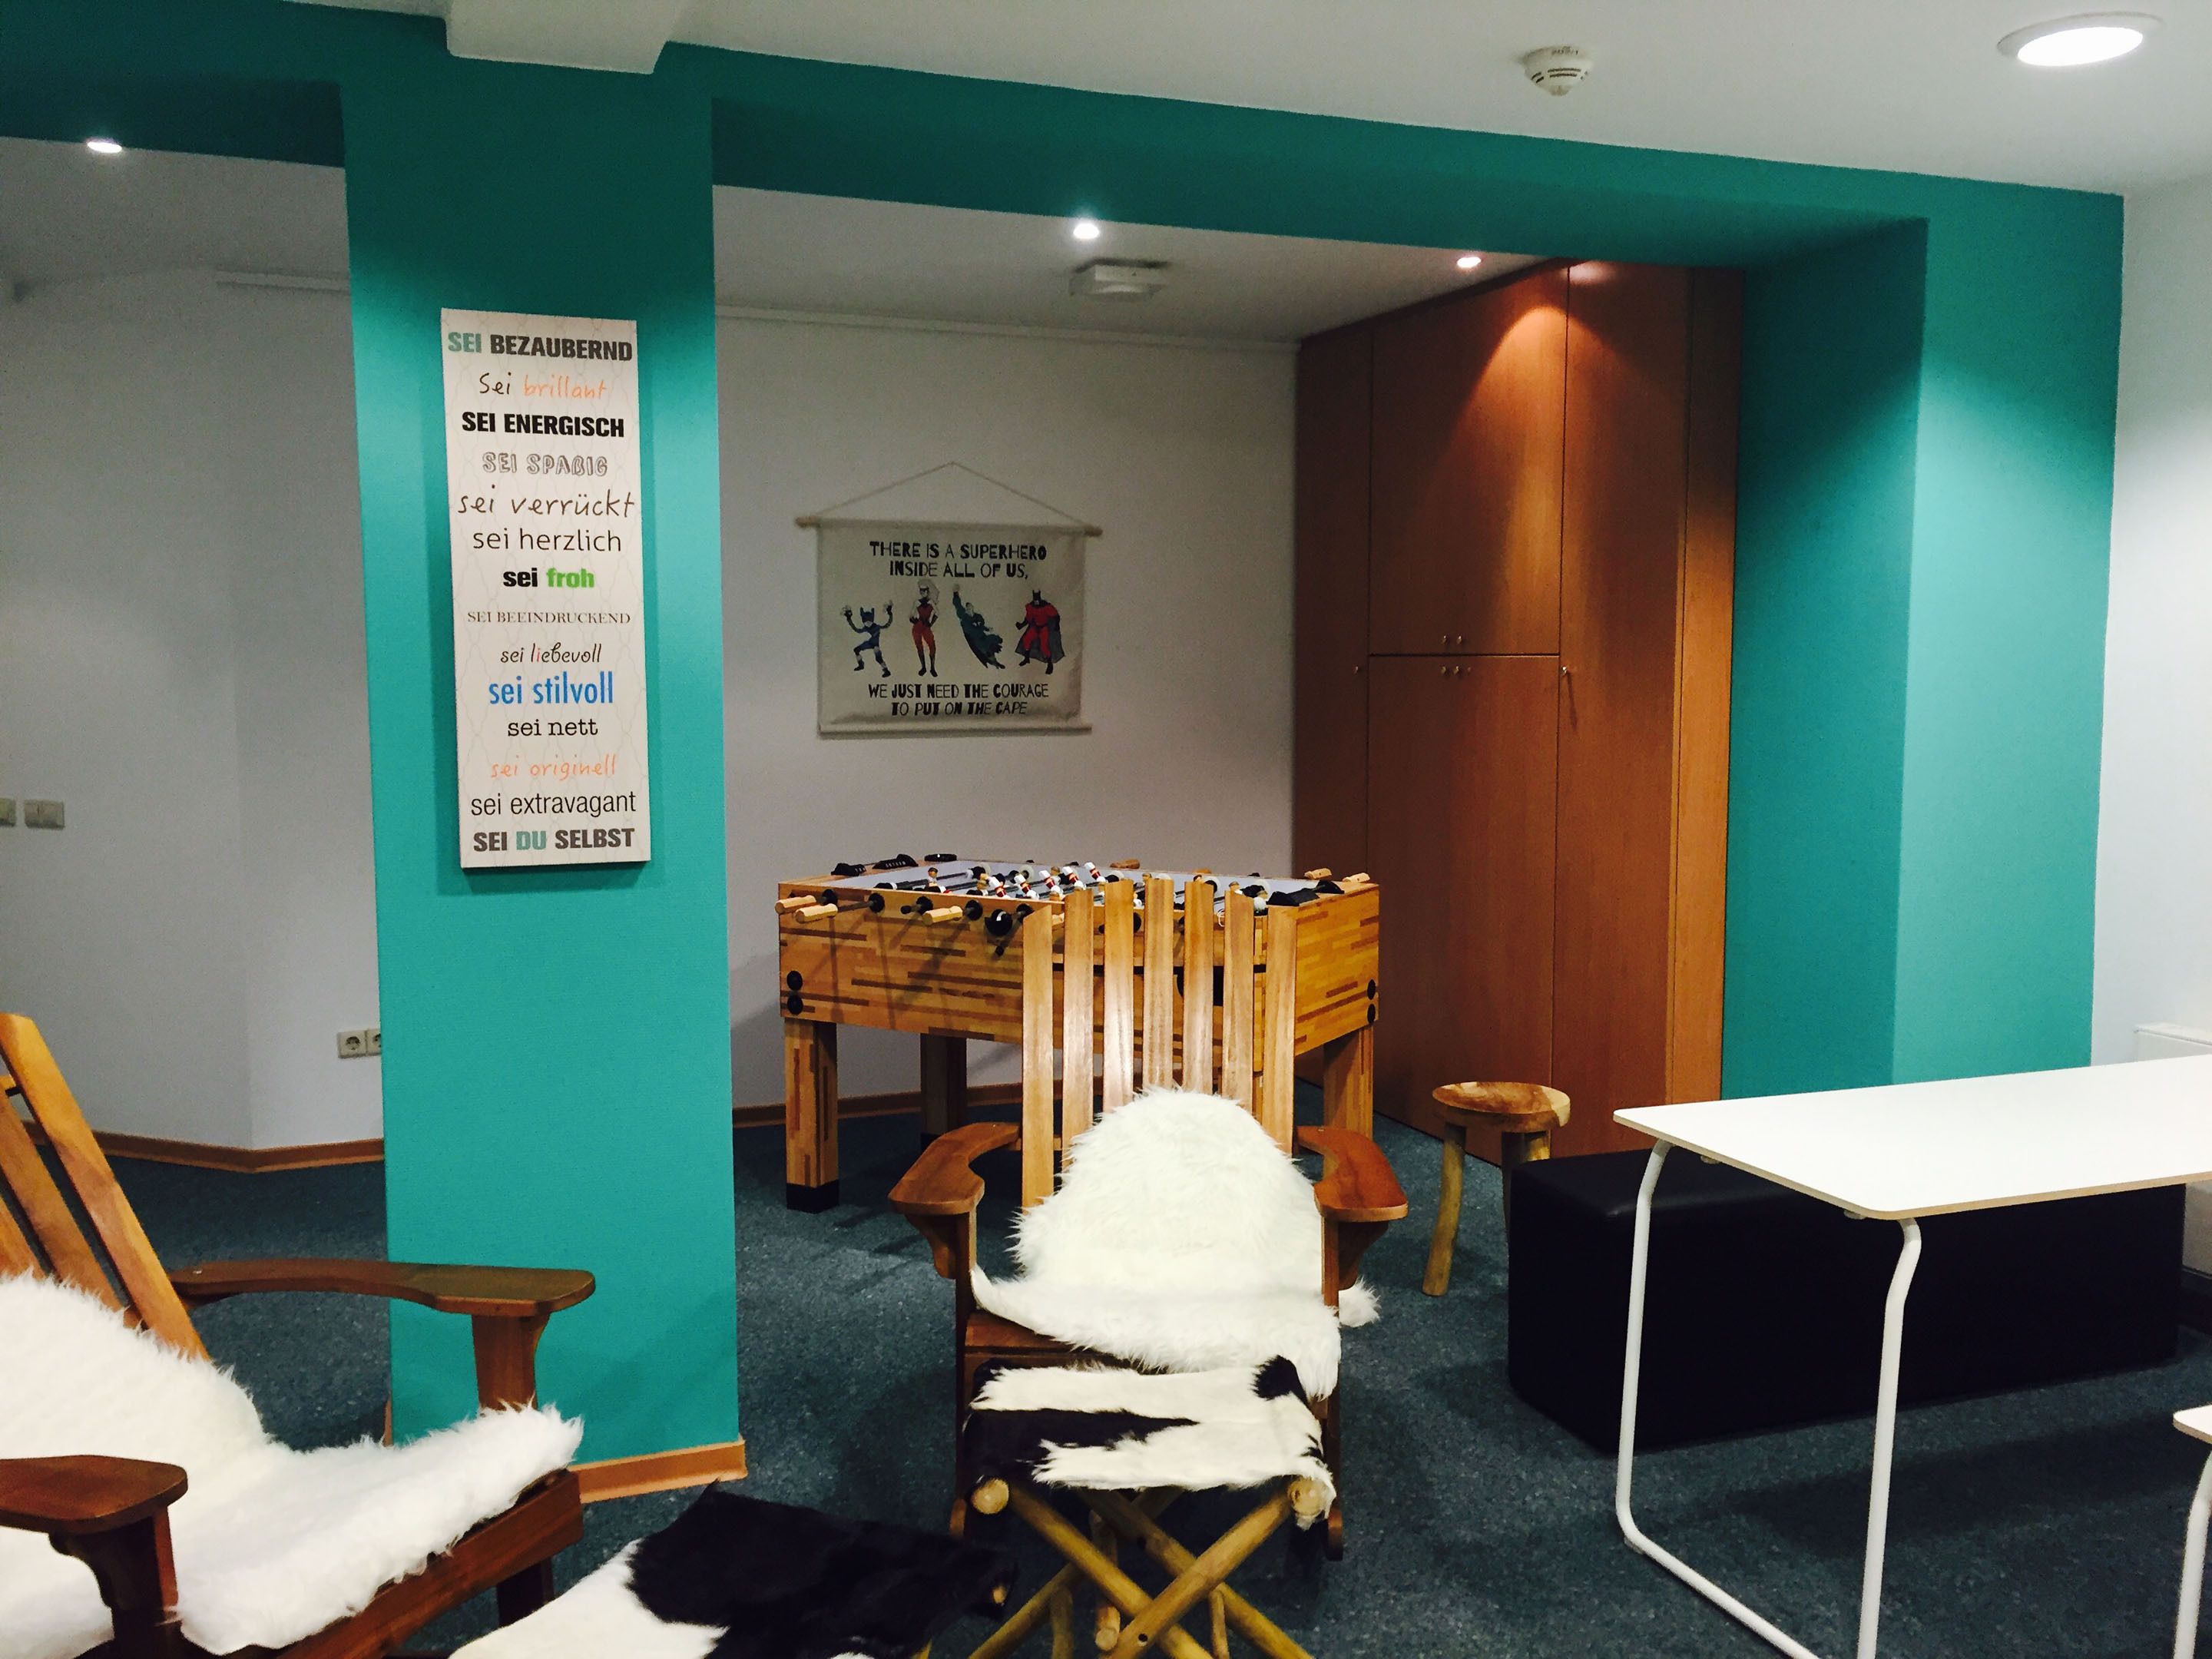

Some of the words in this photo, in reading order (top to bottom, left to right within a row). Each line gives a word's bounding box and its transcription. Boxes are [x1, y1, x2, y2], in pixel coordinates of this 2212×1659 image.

[448, 332, 482, 353] SEI
[490, 334, 632, 362] BEZAUBERND
[479, 372, 512, 395] Sei
[524, 375, 607, 399] brillant
[462, 411, 495, 432] SEI
[504, 413, 624, 437] ENERGISCH
[482, 452, 517, 473] SEI
[458, 484, 495, 513] sei
[512, 489, 634, 518] verrückt
[473, 528, 508, 549] sei
[519, 528, 621, 551] herzlich
[869, 541, 921, 558] THERE
[926, 542, 939, 558] IS
[945, 544, 955, 559] A
[960, 544, 1046, 560] SUPERHERO
[503, 568, 538, 588] sei
[546, 568, 594, 588] froh
[889, 561, 938, 577] INSIDE
[943, 561, 975, 578] ALL
[980, 562, 1000, 578] OF
[467, 611, 492, 622] SEI
[497, 611, 631, 624] BEEINDRUCKEND
[501, 647, 524, 663] sei
[531, 642, 601, 663] liebevoll
[488, 675, 522, 704] sei
[532, 671, 613, 704] stilvoll
[868, 683, 887, 698] WE
[892, 684, 922, 698] JUST
[927, 684, 959, 698] NEED
[963, 684, 988, 698] THE
[993, 684, 1048, 698] COURAGE
[891, 701, 909, 716] TO
[915, 702, 940, 716] PUT
[945, 702, 962, 716] ON
[967, 702, 992, 715] THE
[995, 701, 1028, 715] CAPE
[508, 719, 541, 737] sei
[548, 719, 598, 736] nett
[492, 755, 519, 779] sei
[530, 753, 616, 780] originell
[471, 793, 501, 816] sei
[510, 791, 637, 817] extravagant
[473, 832, 507, 852] SEI
[516, 831, 547, 850] DU
[555, 828, 635, 849] SELBST
